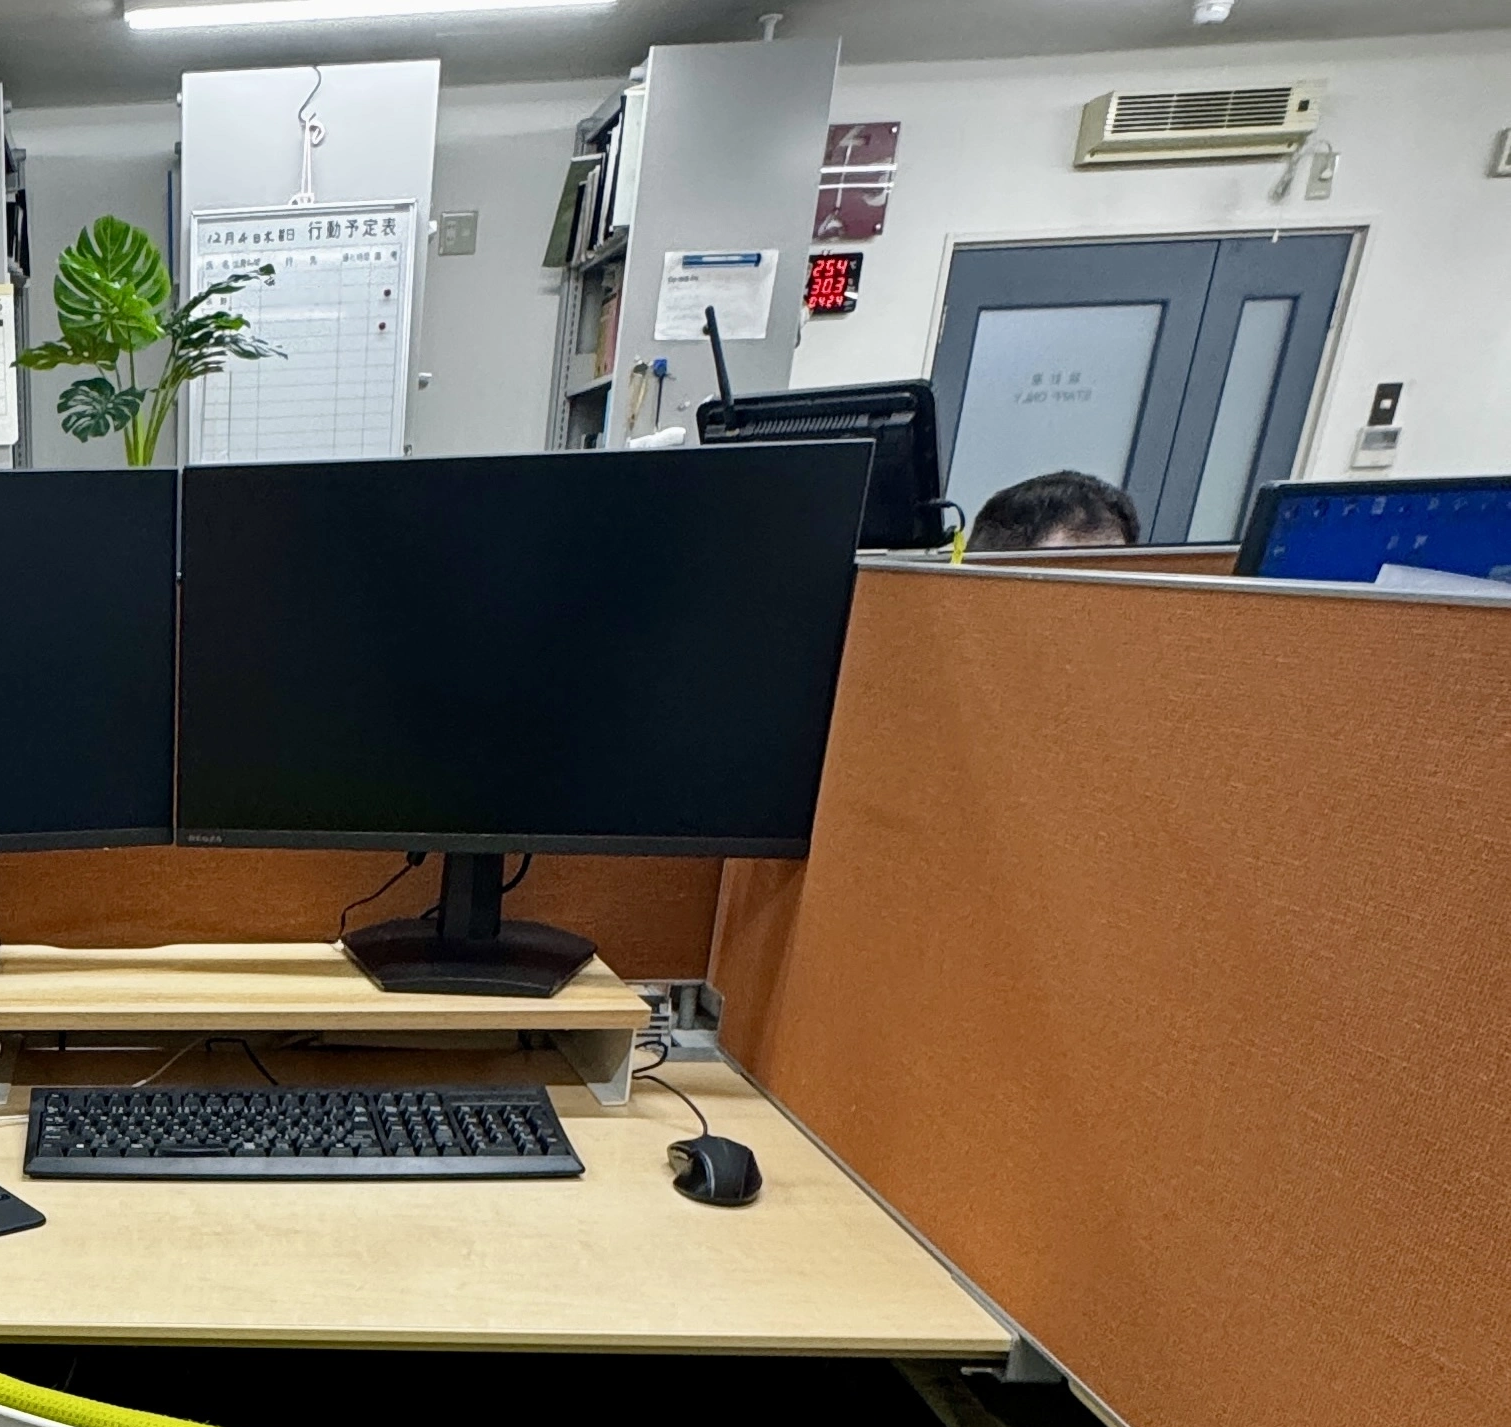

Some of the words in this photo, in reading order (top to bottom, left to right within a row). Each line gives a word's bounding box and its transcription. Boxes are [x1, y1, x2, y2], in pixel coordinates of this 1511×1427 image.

[308, 218, 396, 241] 行動予定表
